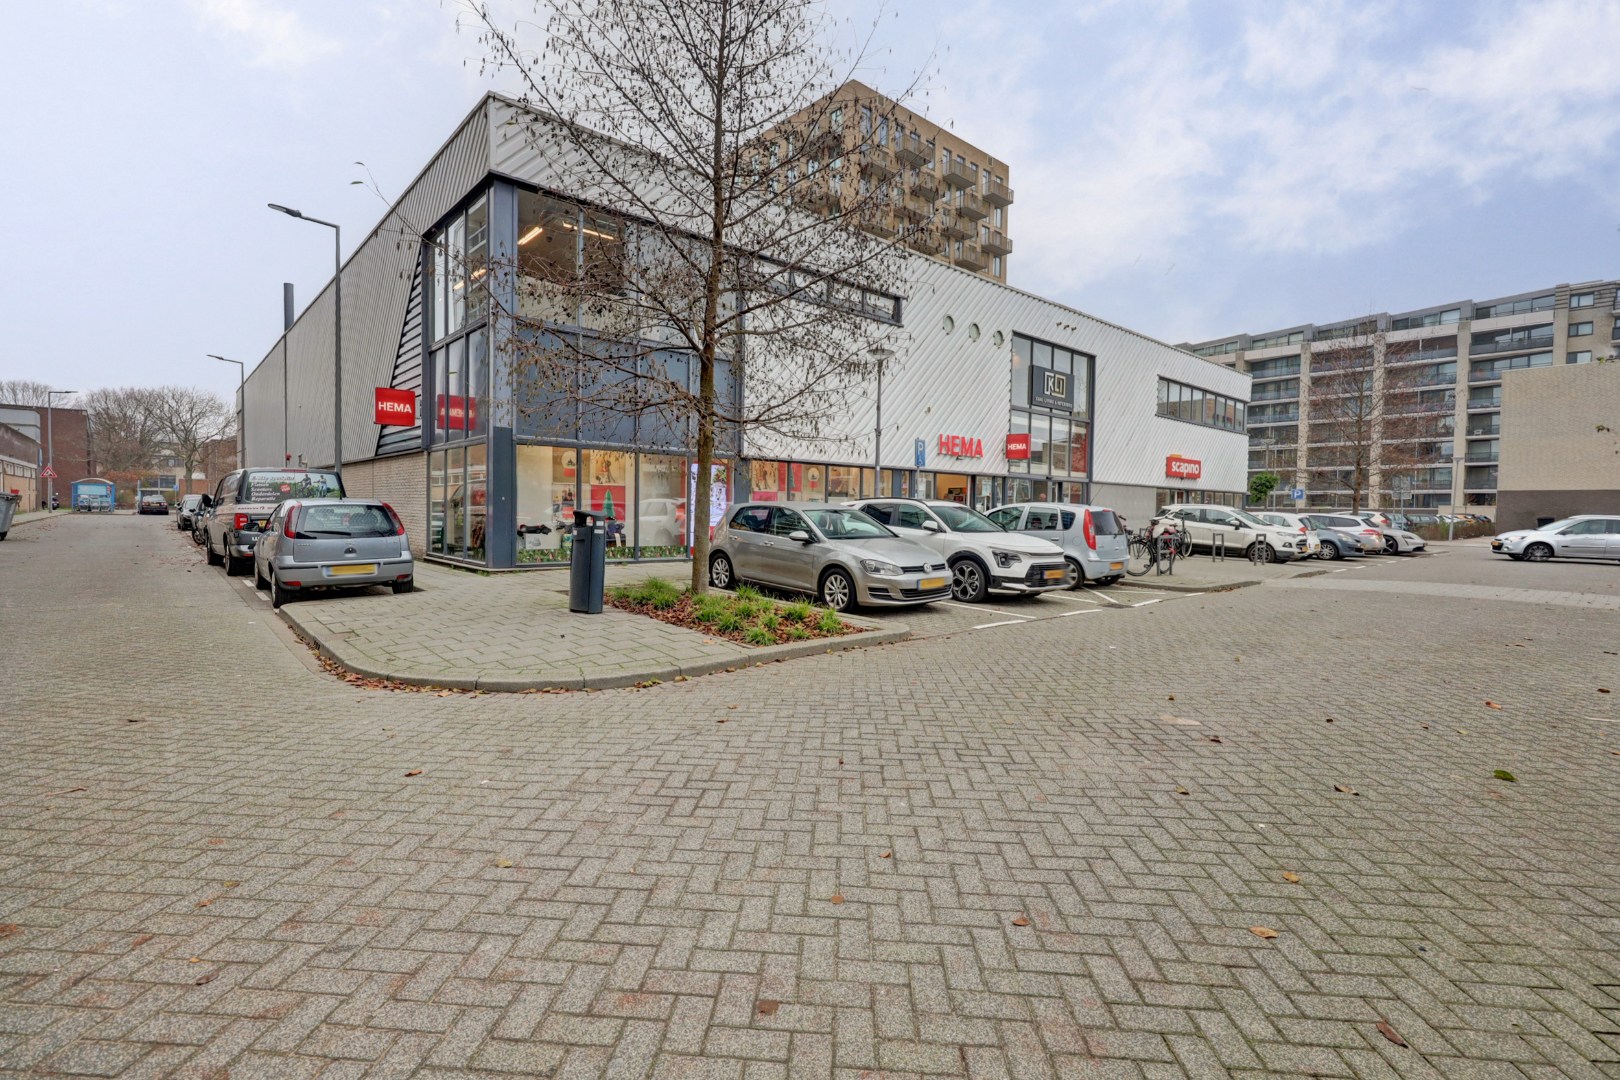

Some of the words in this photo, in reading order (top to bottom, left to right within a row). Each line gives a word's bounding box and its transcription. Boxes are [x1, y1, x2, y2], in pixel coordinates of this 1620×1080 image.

[378, 401, 412, 413] HEMA
[939, 434, 983, 458] HEMA
[1007, 443, 1027, 451] HEMA
[1171, 461, 1200, 477] scapino
